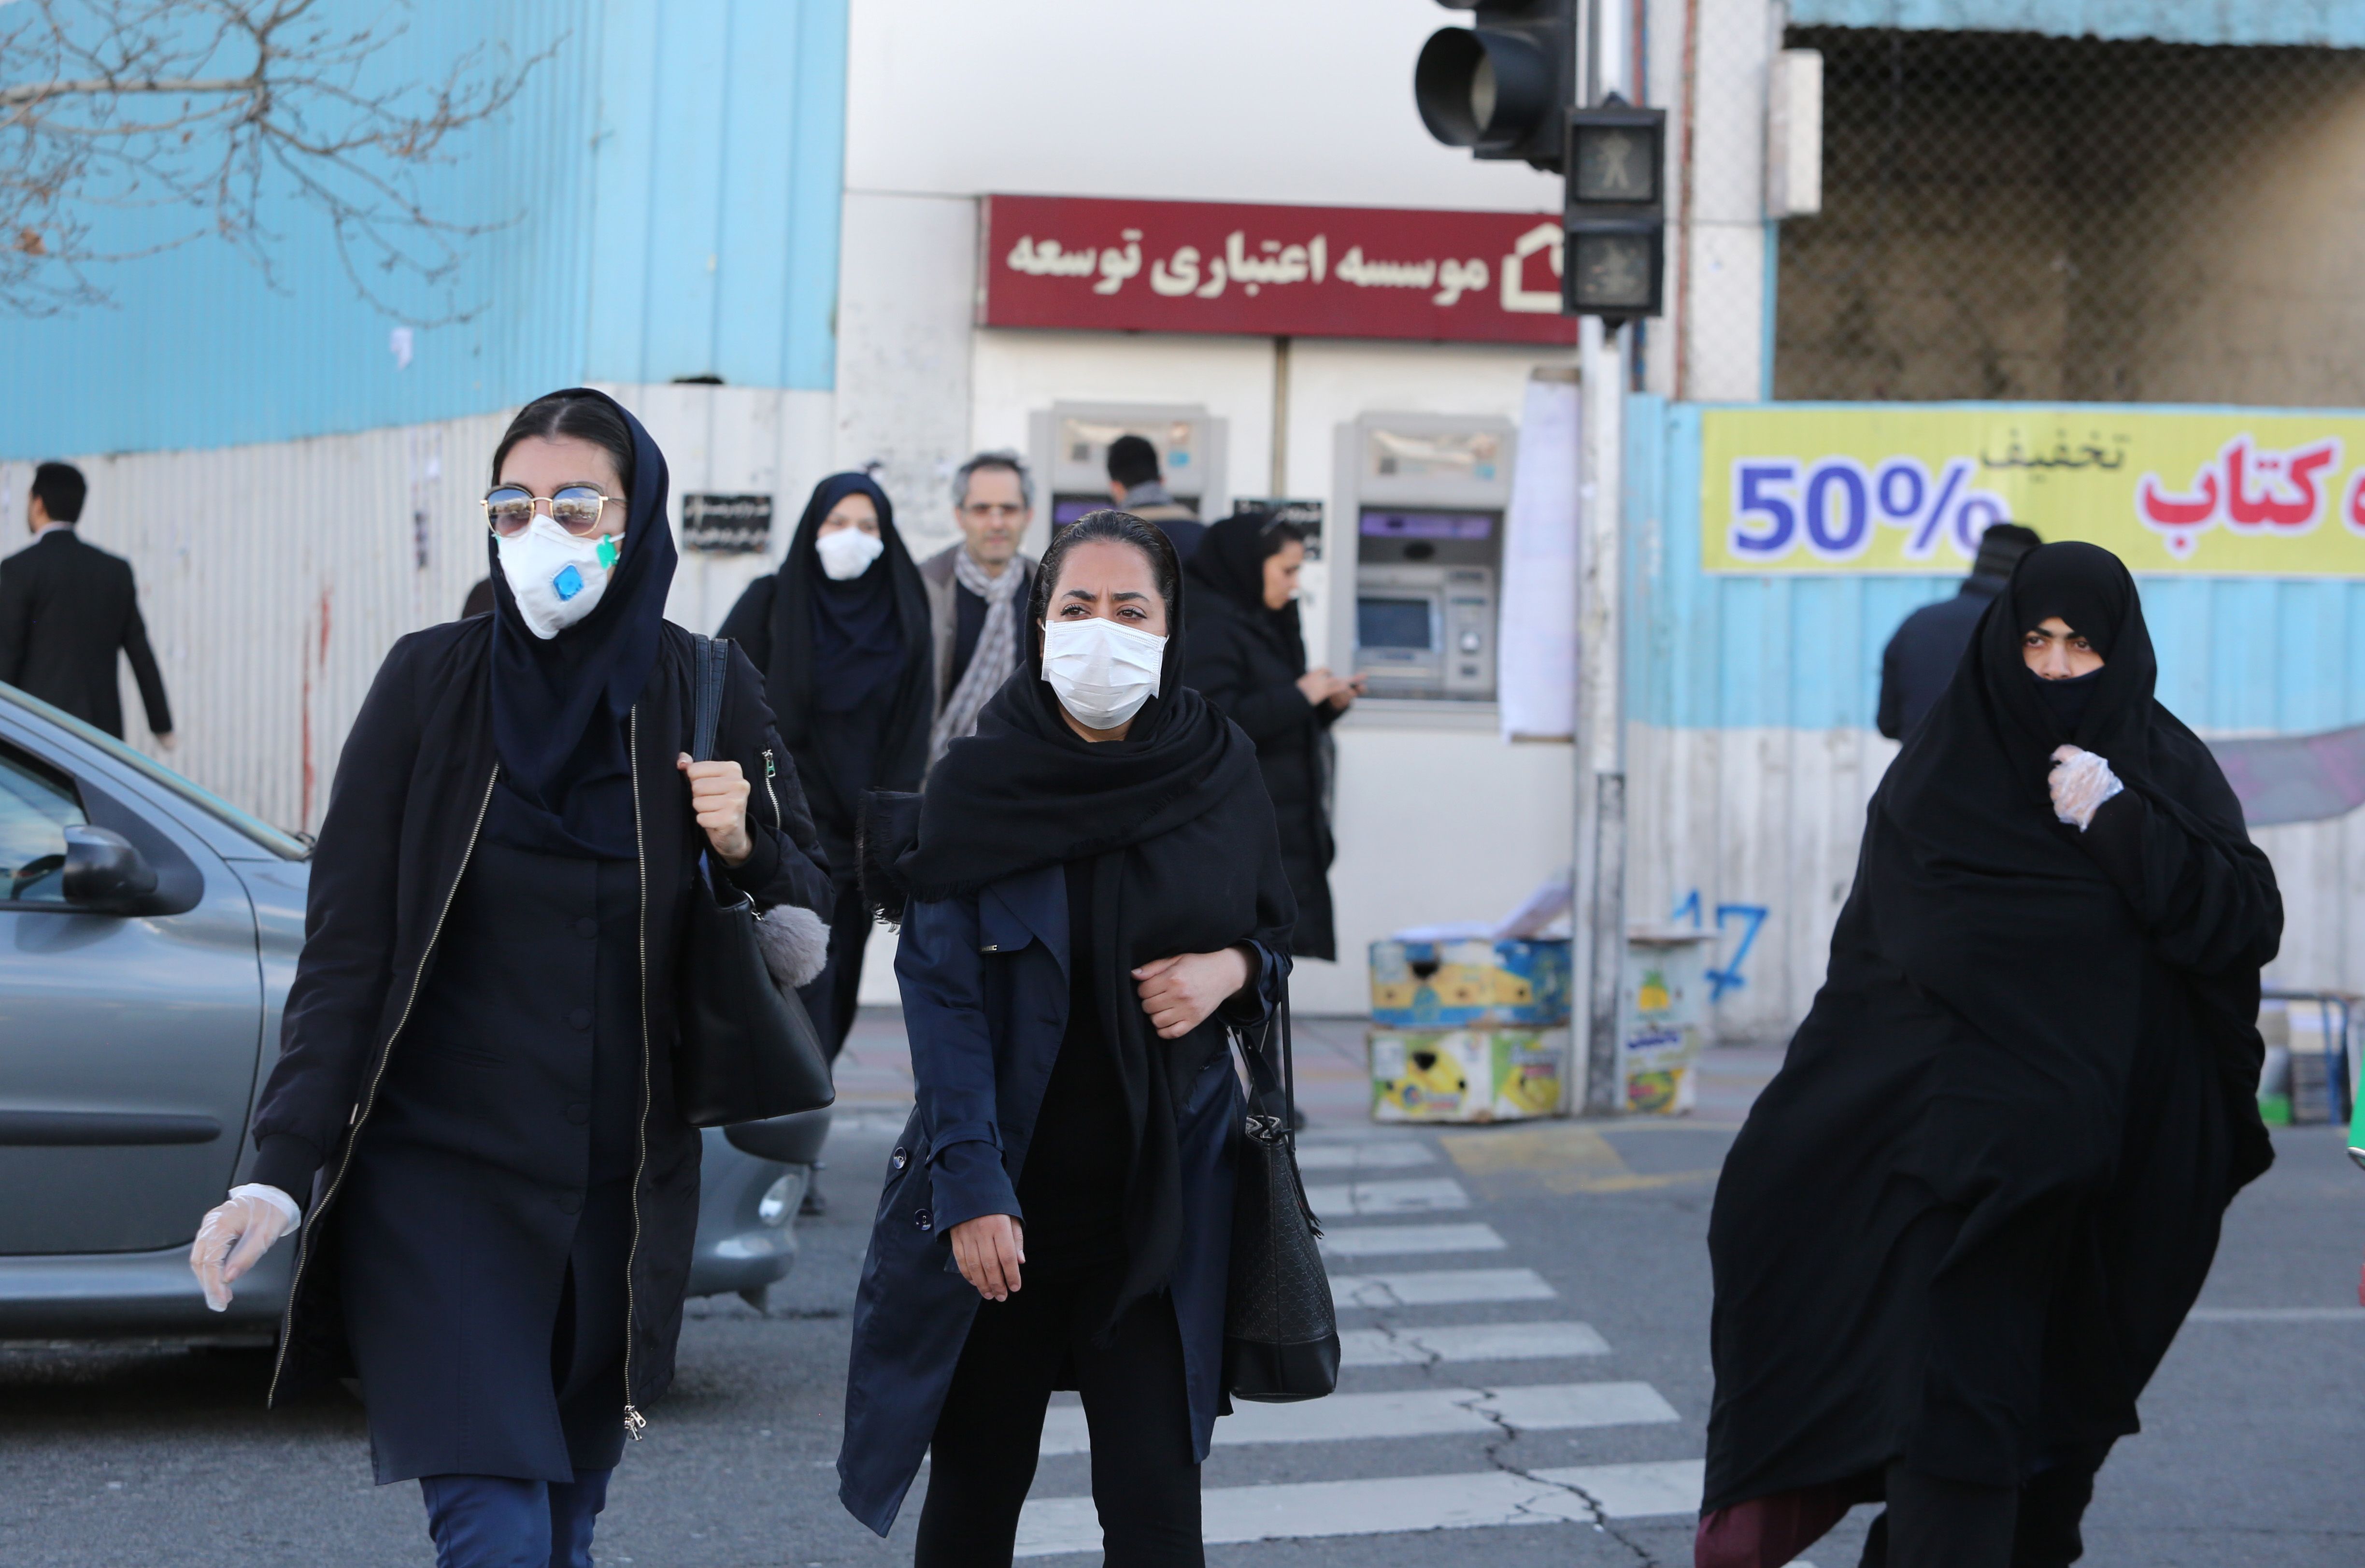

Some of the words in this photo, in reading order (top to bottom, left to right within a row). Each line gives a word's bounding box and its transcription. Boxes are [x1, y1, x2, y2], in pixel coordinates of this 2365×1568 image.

[1007, 229, 1143, 295] توسعه
[1150, 230, 1327, 299] اعتباری
[1335, 246, 1490, 307] موسسه
[1980, 428, 2132, 483] تخفیف
[1734, 461, 2000, 554] 50%
[2142, 443, 2334, 549] کتاب
